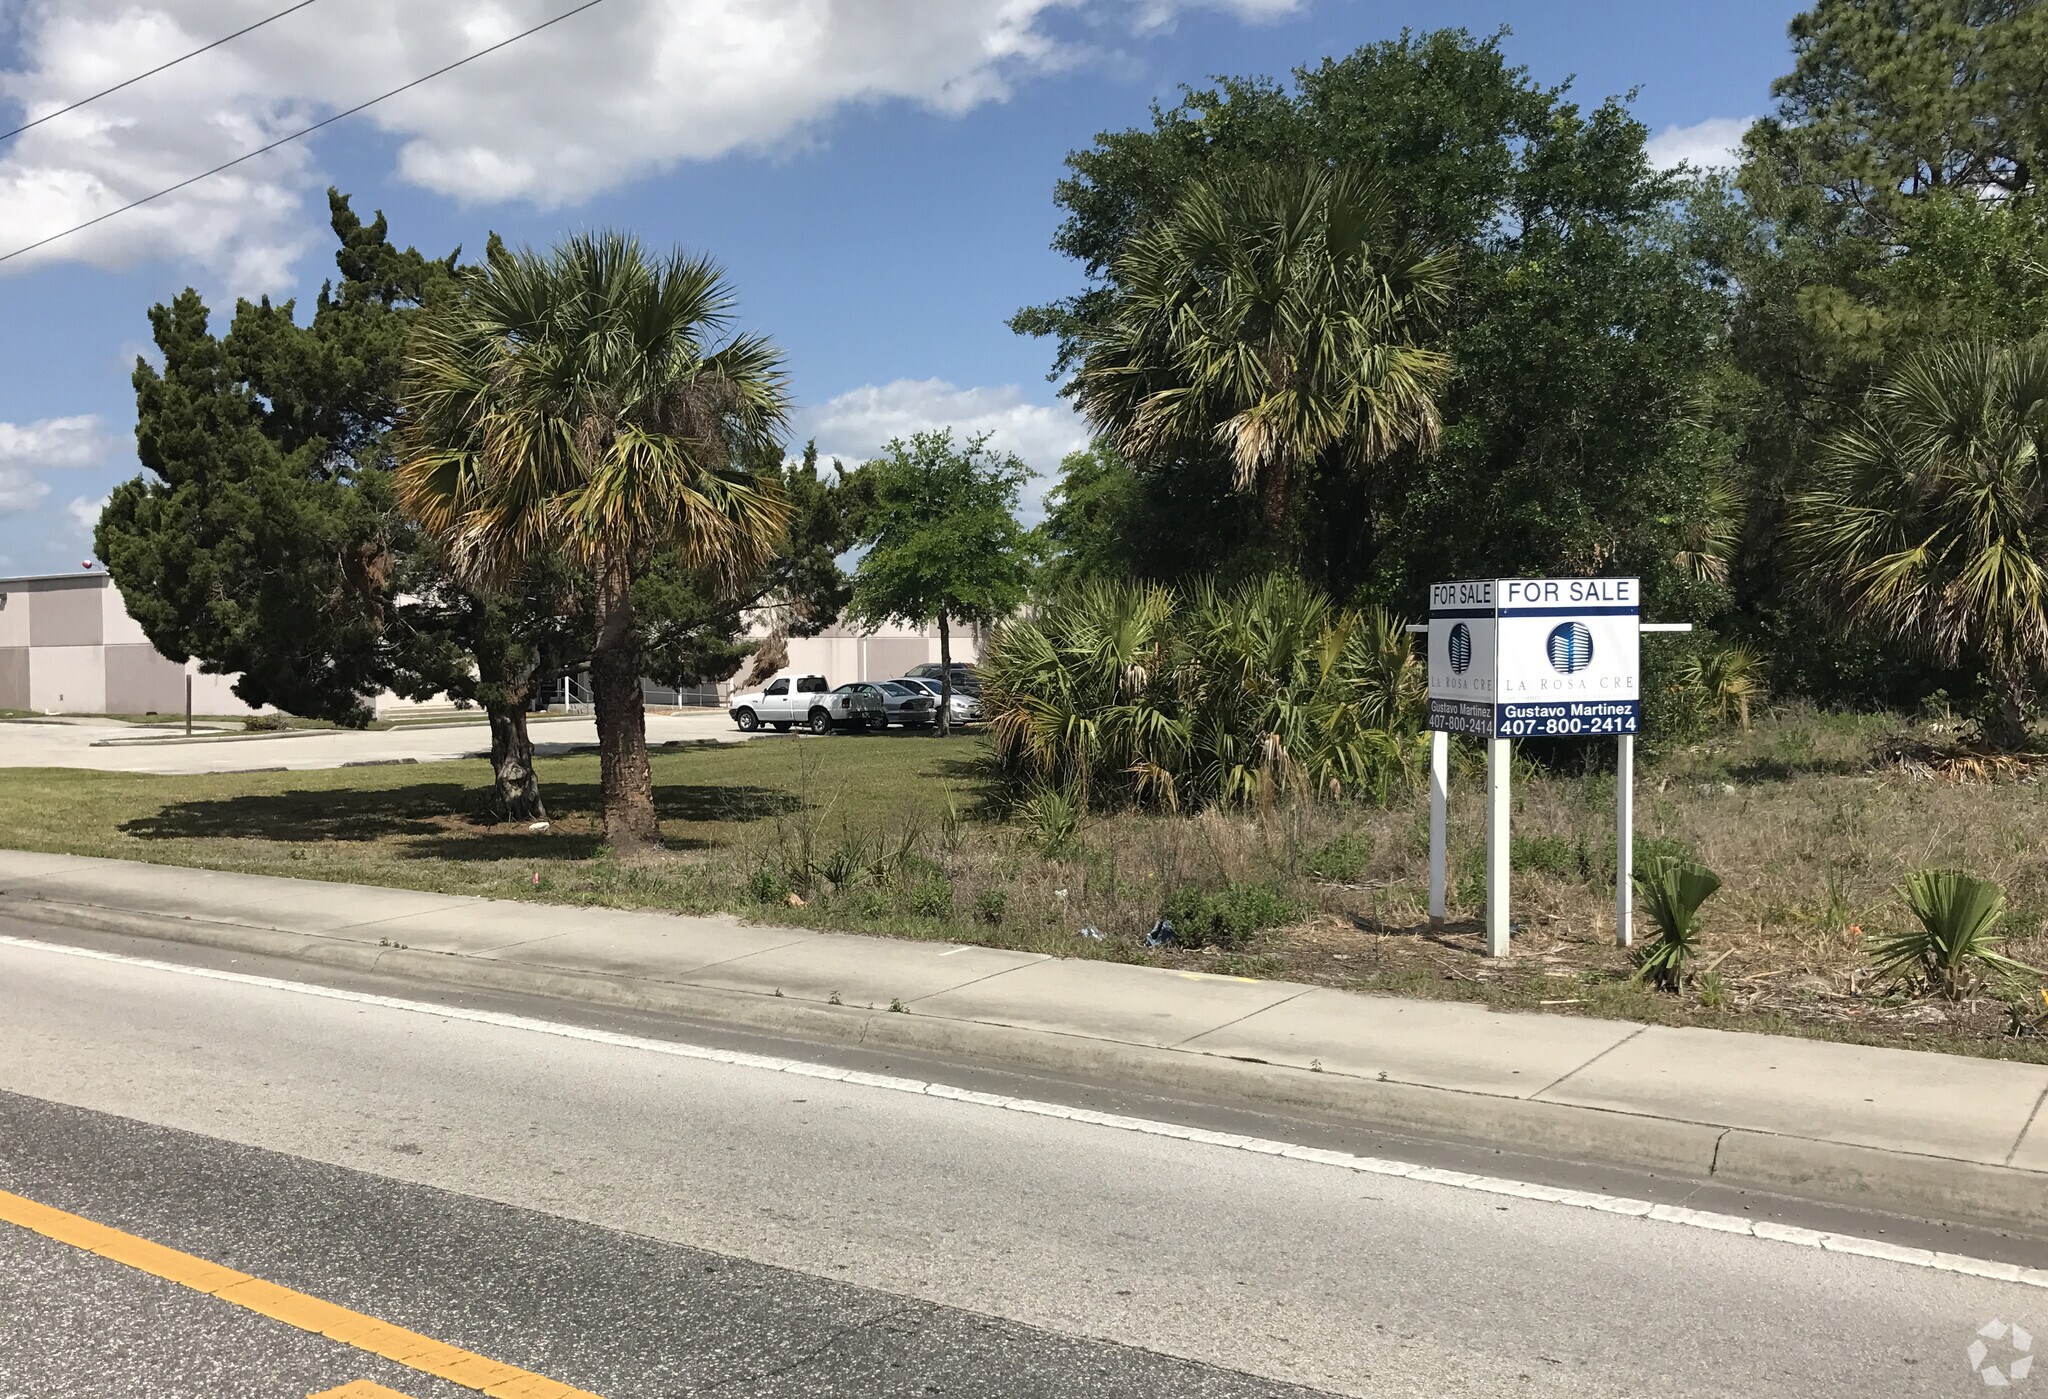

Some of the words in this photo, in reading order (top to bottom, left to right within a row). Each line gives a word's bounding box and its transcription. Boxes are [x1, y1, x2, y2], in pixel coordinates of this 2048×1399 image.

[1433, 585, 1456, 605] FOR
[1459, 583, 1491, 604] SALE
[1509, 582, 1559, 602] FOR
[1569, 582, 1629, 602] SALE
[1431, 676, 1441, 688] LA
[1445, 677, 1468, 689] ROSA
[1473, 678, 1492, 691] CRE
[1506, 679, 1527, 691] LA
[1541, 678, 1586, 690] ROSA
[1600, 676, 1633, 689] CRE
[1431, 700, 1457, 715] Gustavo
[1459, 702, 1491, 718] Martinez
[1505, 705, 1565, 718] Gustavo
[1570, 703, 1632, 717] Martinez
[1429, 714, 1493, 735] 407-800-2414
[1500, 716, 1637, 735] 407-800-2414
